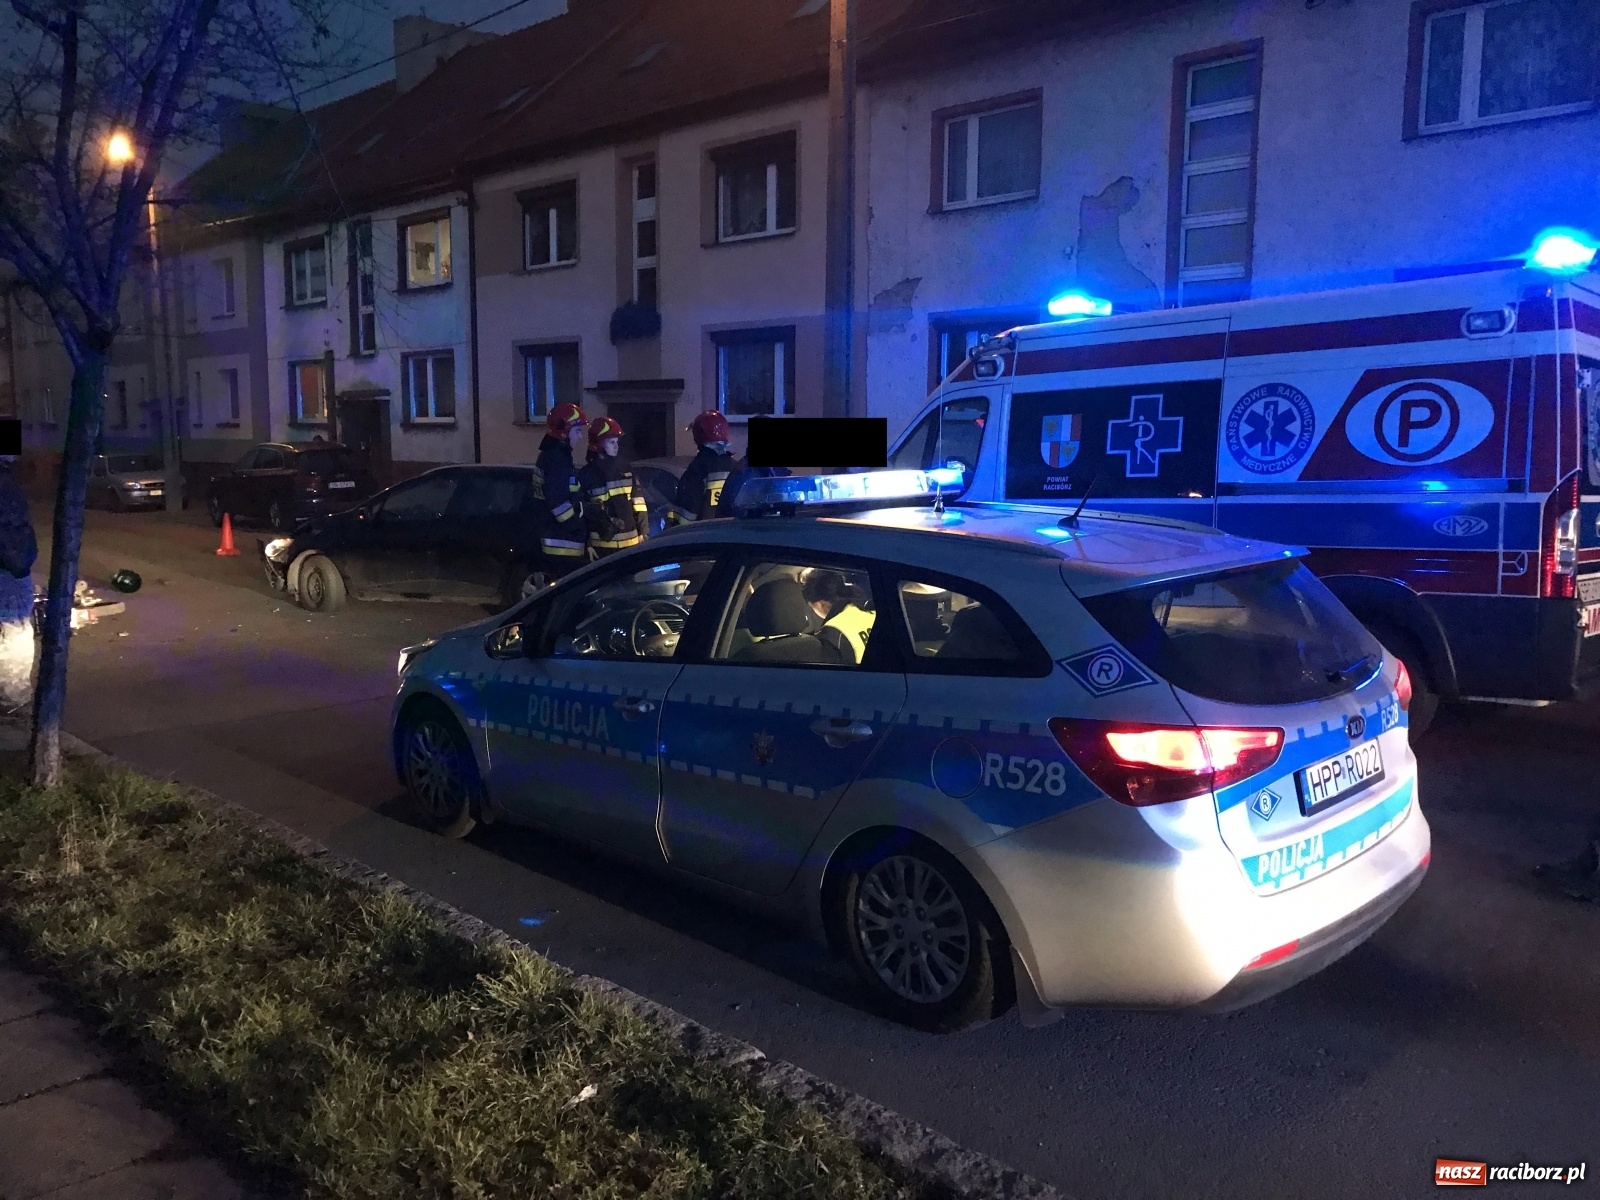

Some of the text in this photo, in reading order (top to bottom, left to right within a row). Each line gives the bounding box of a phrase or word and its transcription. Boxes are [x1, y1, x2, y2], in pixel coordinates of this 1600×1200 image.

[1226, 386, 1313, 451] PAŃSTWOWE RATOWNICTWO
[1398, 398, 1442, 448] P
[1241, 453, 1297, 472] MEDYCZNE
[1043, 483, 1072, 491] RACIBÓRZ
[1096, 661, 1113, 681] R
[526, 693, 610, 741] POLICJA
[1381, 702, 1399, 732] R528
[984, 752, 1067, 797] R528
[1309, 744, 1380, 801] HPP R022
[1257, 834, 1325, 883] POLICJA
